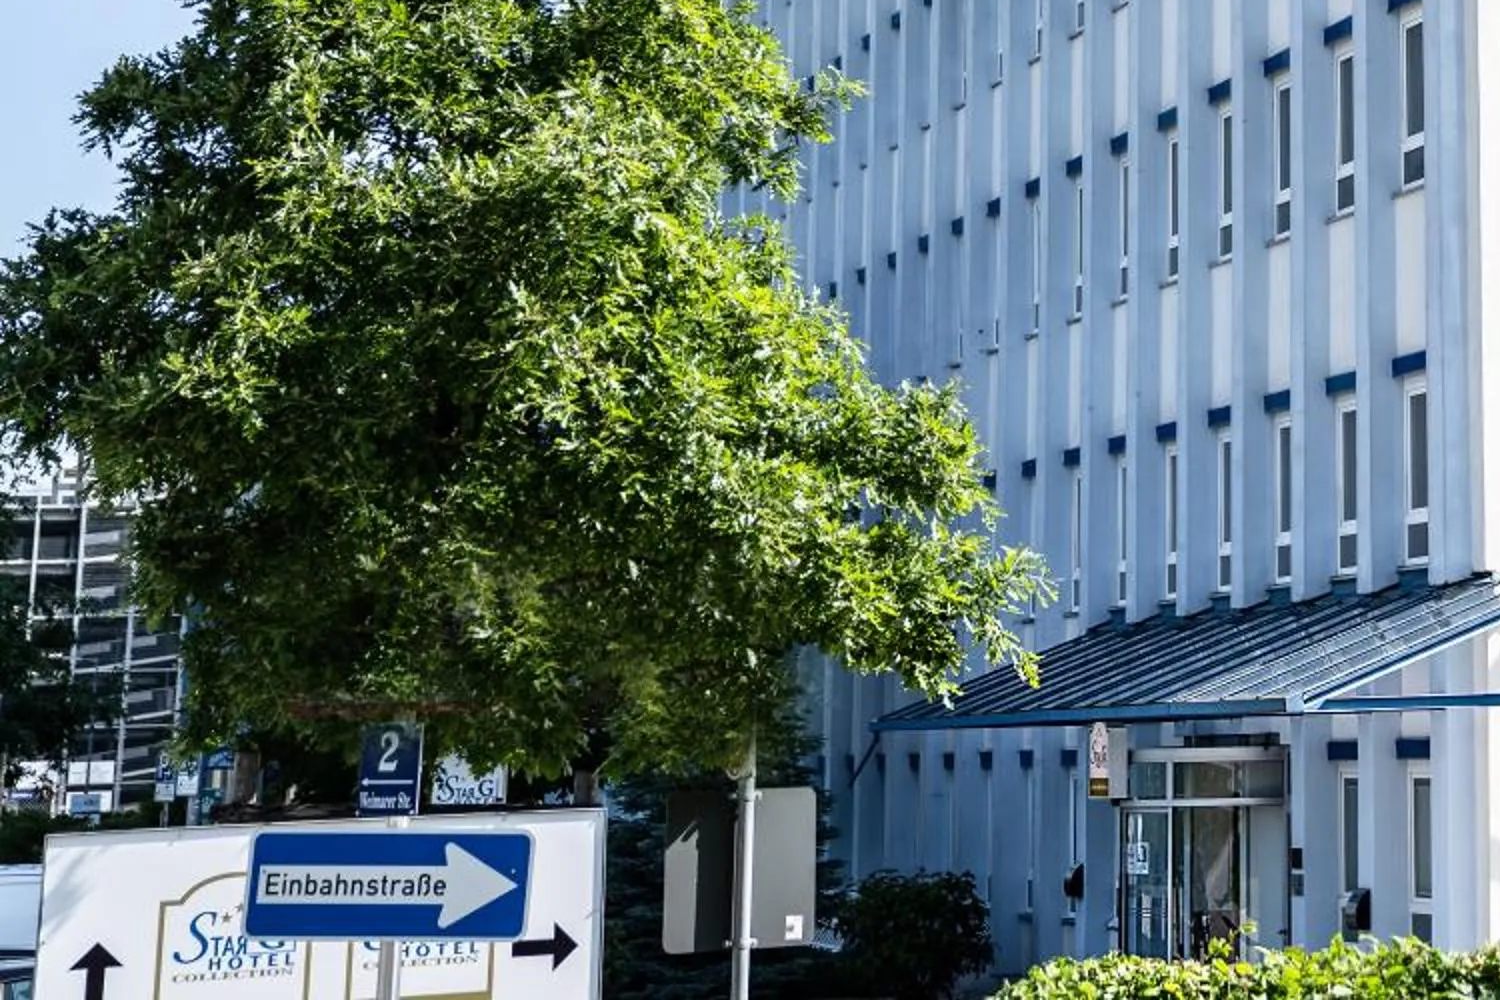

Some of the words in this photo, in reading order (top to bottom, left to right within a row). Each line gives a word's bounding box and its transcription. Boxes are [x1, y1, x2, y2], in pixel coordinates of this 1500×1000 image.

[378, 731, 399, 772] 2
[264, 873, 447, 897] Einbahnstraße
[208, 953, 295, 972] HOTEL
[172, 967, 294, 984] COLLECTION
